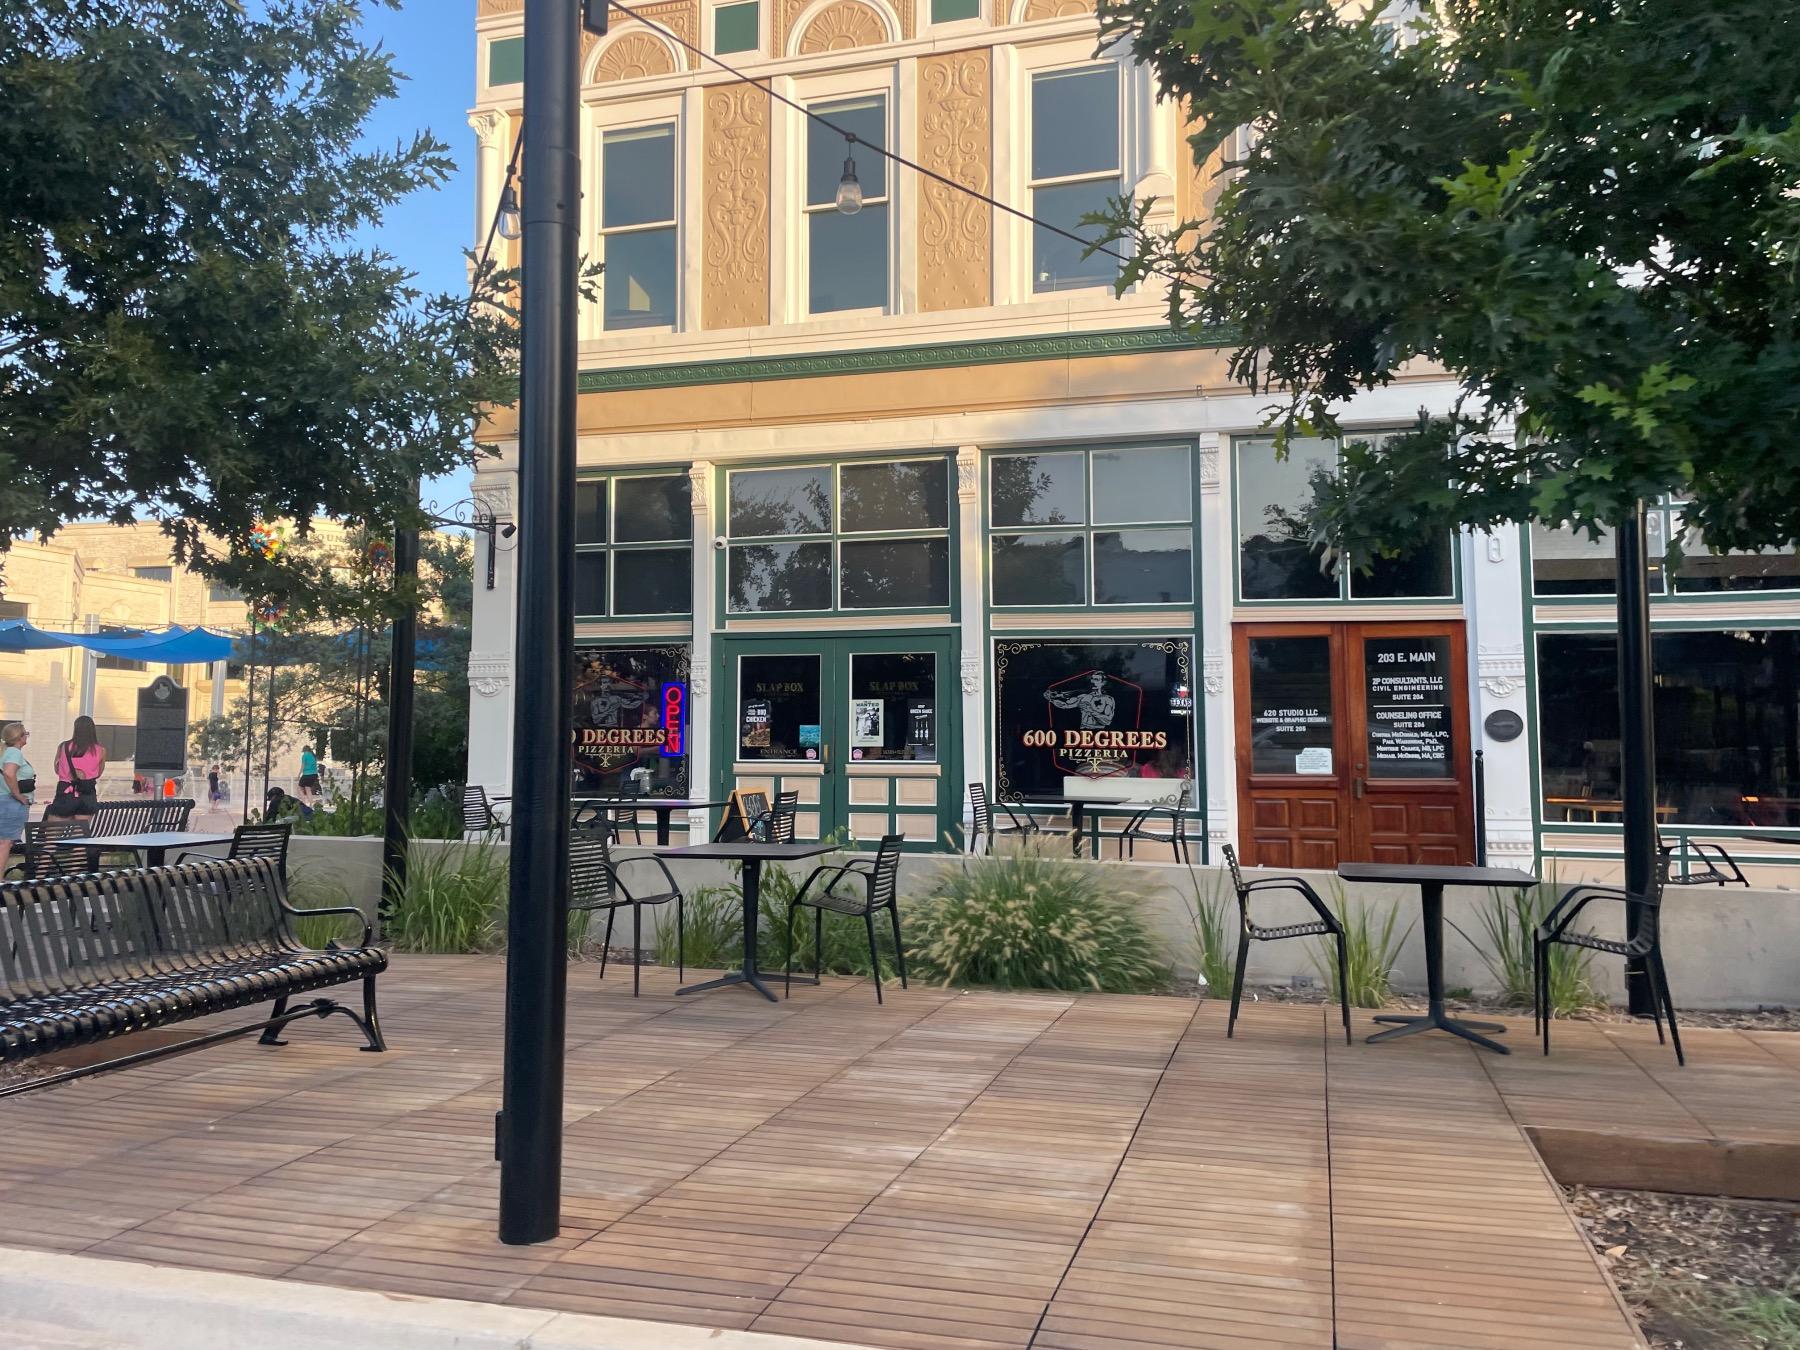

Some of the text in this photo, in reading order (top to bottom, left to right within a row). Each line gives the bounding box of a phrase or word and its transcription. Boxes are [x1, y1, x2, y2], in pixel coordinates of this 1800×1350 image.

[1377, 652, 1436, 663] 203 E. MAIN
[1381, 676, 1429, 684] CONSULTANTS,
[1429, 676, 1443, 684] LLC
[1263, 708, 1319, 717] 620 STUDIO LLC
[1376, 711, 1442, 720] COUNSELING OFFICE
[665, 686, 682, 753] OPEN
[582, 728, 666, 744] DEGREES
[1022, 729, 1167, 748] 600 DEGREES
[578, 745, 634, 753] PIZZERIA
[1059, 749, 1129, 758] PIZZERIA
